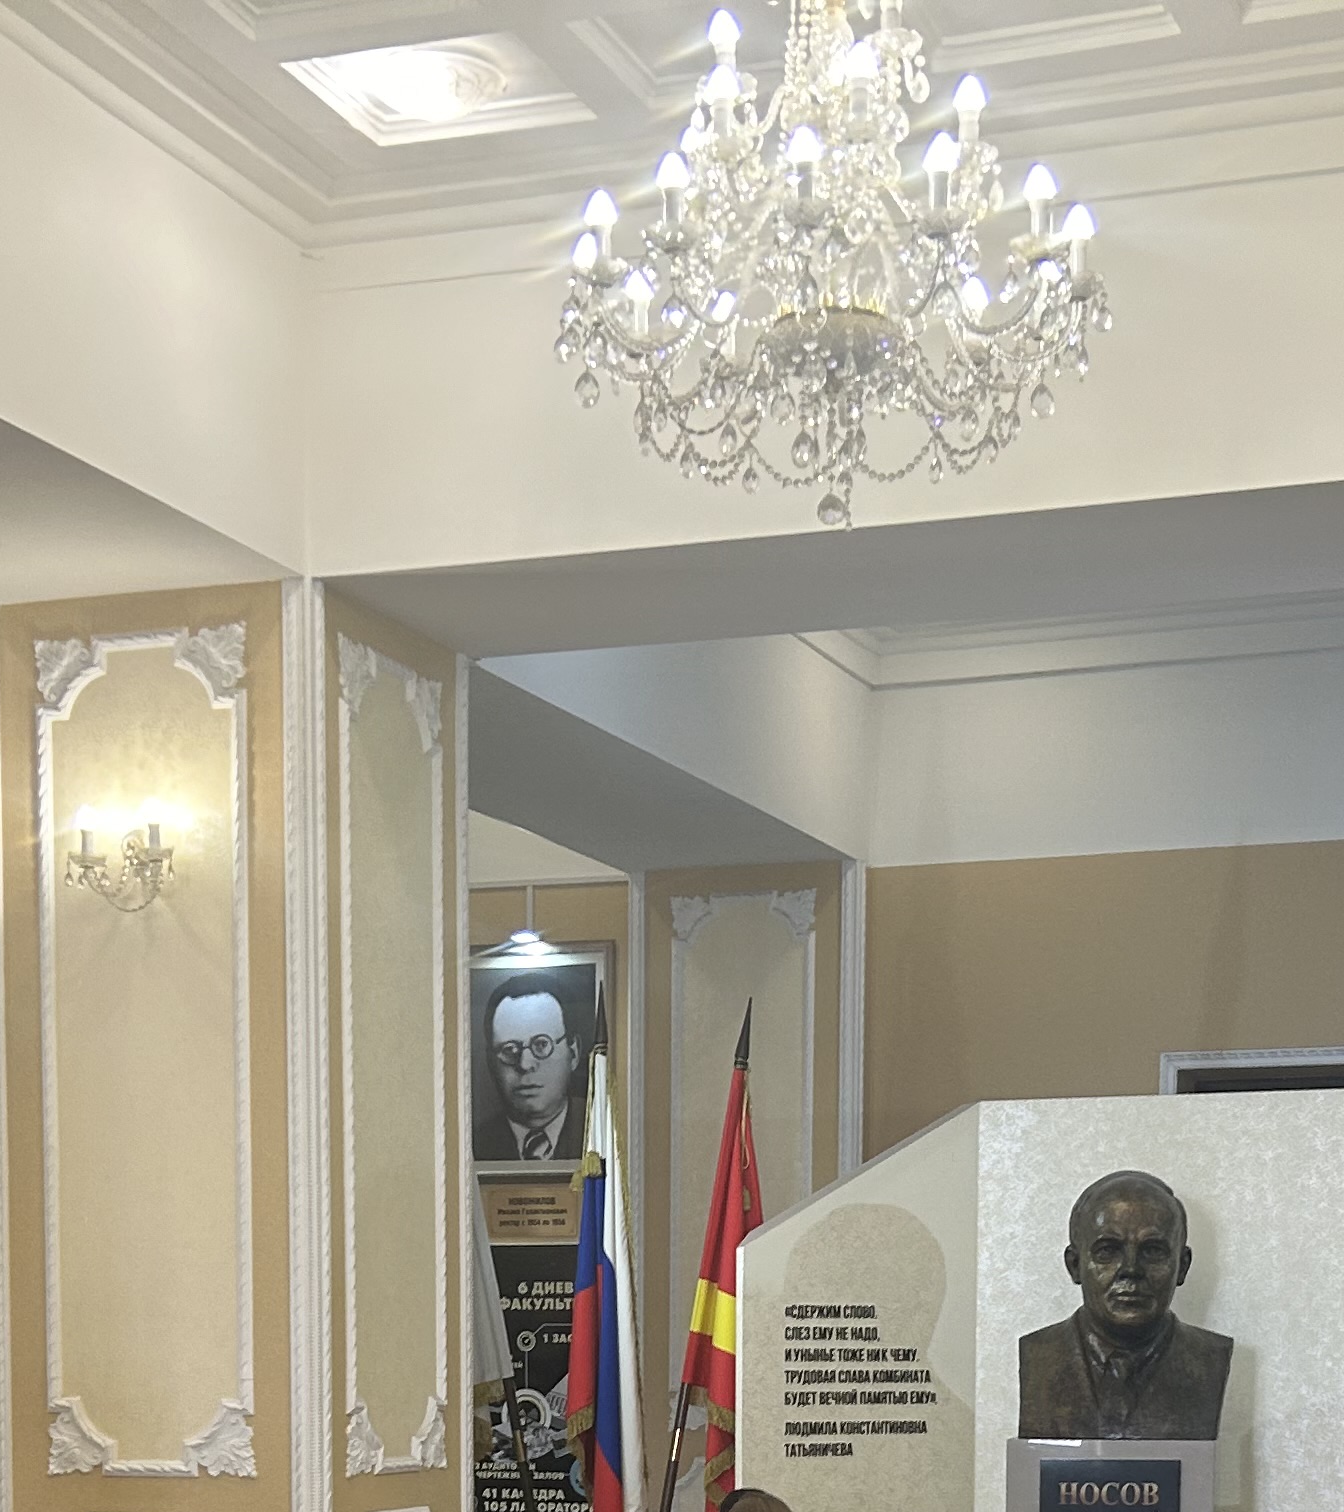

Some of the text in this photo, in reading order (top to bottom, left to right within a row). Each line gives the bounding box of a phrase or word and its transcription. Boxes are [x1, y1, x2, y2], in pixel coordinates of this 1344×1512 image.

[517, 1281, 574, 1297] 6 ДНЕВ
[499, 1296, 574, 1311] ФАКУЛЬТ
[784, 1326, 881, 1342] СЛЕЗ ЕМУ НЕ НАДО,
[784, 1348, 792, 1362] И
[793, 1348, 836, 1362] УНЫНЬЕ
[838, 1348, 865, 1362] ТОЖЕ
[784, 1369, 932, 1385] ТРУДОВАЯ СЛАВА КОМБИНАТА
[784, 1391, 817, 1407] БУДЕТ
[819, 1388, 858, 1406] ВЕЧНОЙ
[859, 1390, 908, 1405] ПАМЯТЬЮ
[784, 1420, 928, 1437] ЛЮДМИЛА КОНСТАНТИНОВНА
[784, 1442, 854, 1458] ТАТЬЯНИЧЕВА
[482, 1487, 498, 1500] 41
[1058, 1481, 1160, 1506] НОСОВ
[483, 1500, 508, 1512] 105
